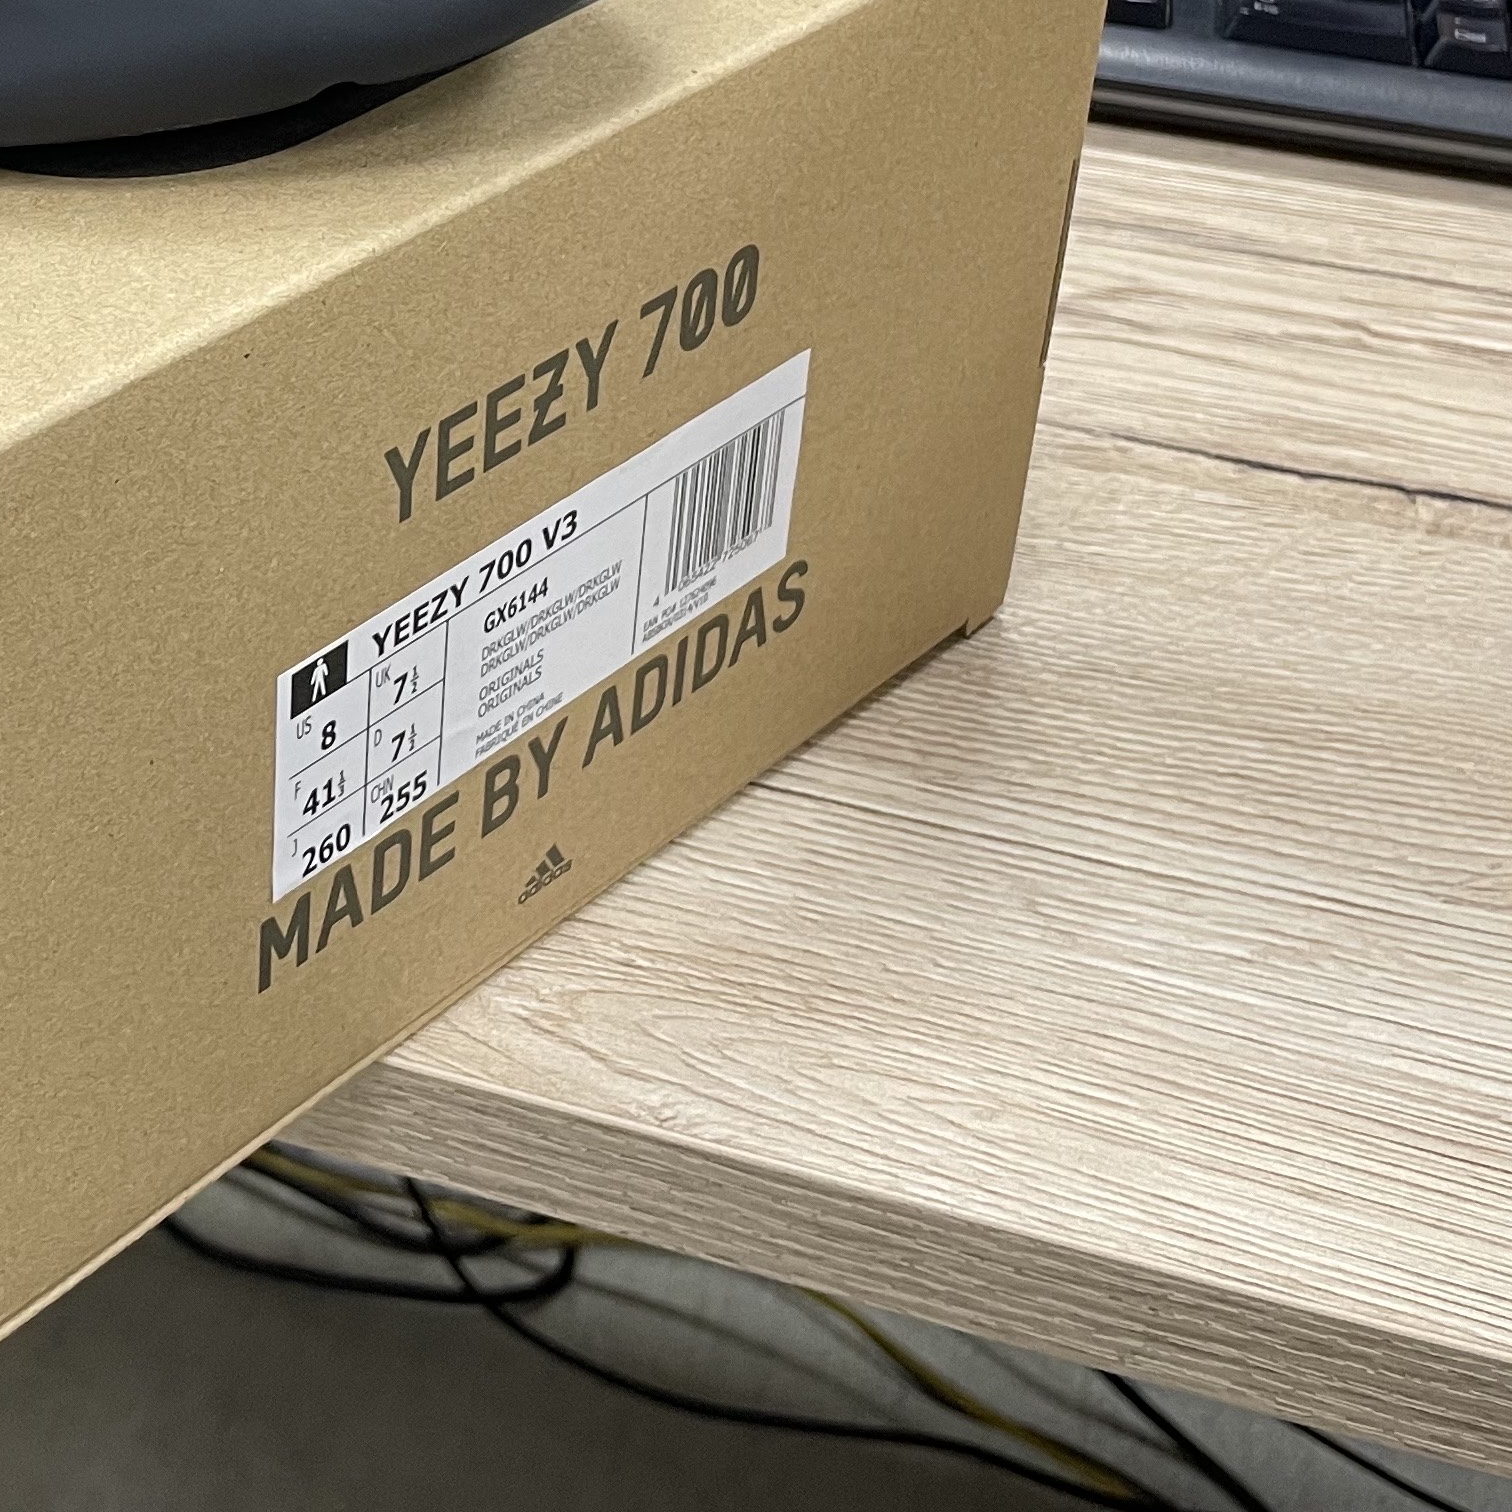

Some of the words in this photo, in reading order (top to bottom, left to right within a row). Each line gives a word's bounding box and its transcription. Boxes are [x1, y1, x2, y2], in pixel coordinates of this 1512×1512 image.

[383, 319, 619, 524] YEEZY
[640, 244, 760, 378] 700
[372, 577, 470, 659] YEEZY
[478, 538, 533, 594] 700
[543, 509, 578, 552] V3
[481, 559, 622, 661] DRKGLW/DRKGLW/DRKGLW
[483, 576, 550, 634] GX6144
[480, 577, 621, 678] DRKGLW/DRKGLW/DRKGLW
[375, 662, 392, 688] UK
[477, 665, 543, 718] ORIGINALS
[478, 648, 544, 701] ORIGINALS
[296, 715, 312, 740] US
[320, 719, 337, 751] 8
[373, 728, 383, 748] D
[257, 790, 460, 995] MADE
[481, 717, 569, 839] BY
[582, 559, 810, 770] ADIDAS
[294, 781, 302, 800] F
[370, 774, 394, 804] CHN
[379, 770, 428, 824] 255
[302, 823, 352, 878] 260
[518, 859, 573, 904] adidas
